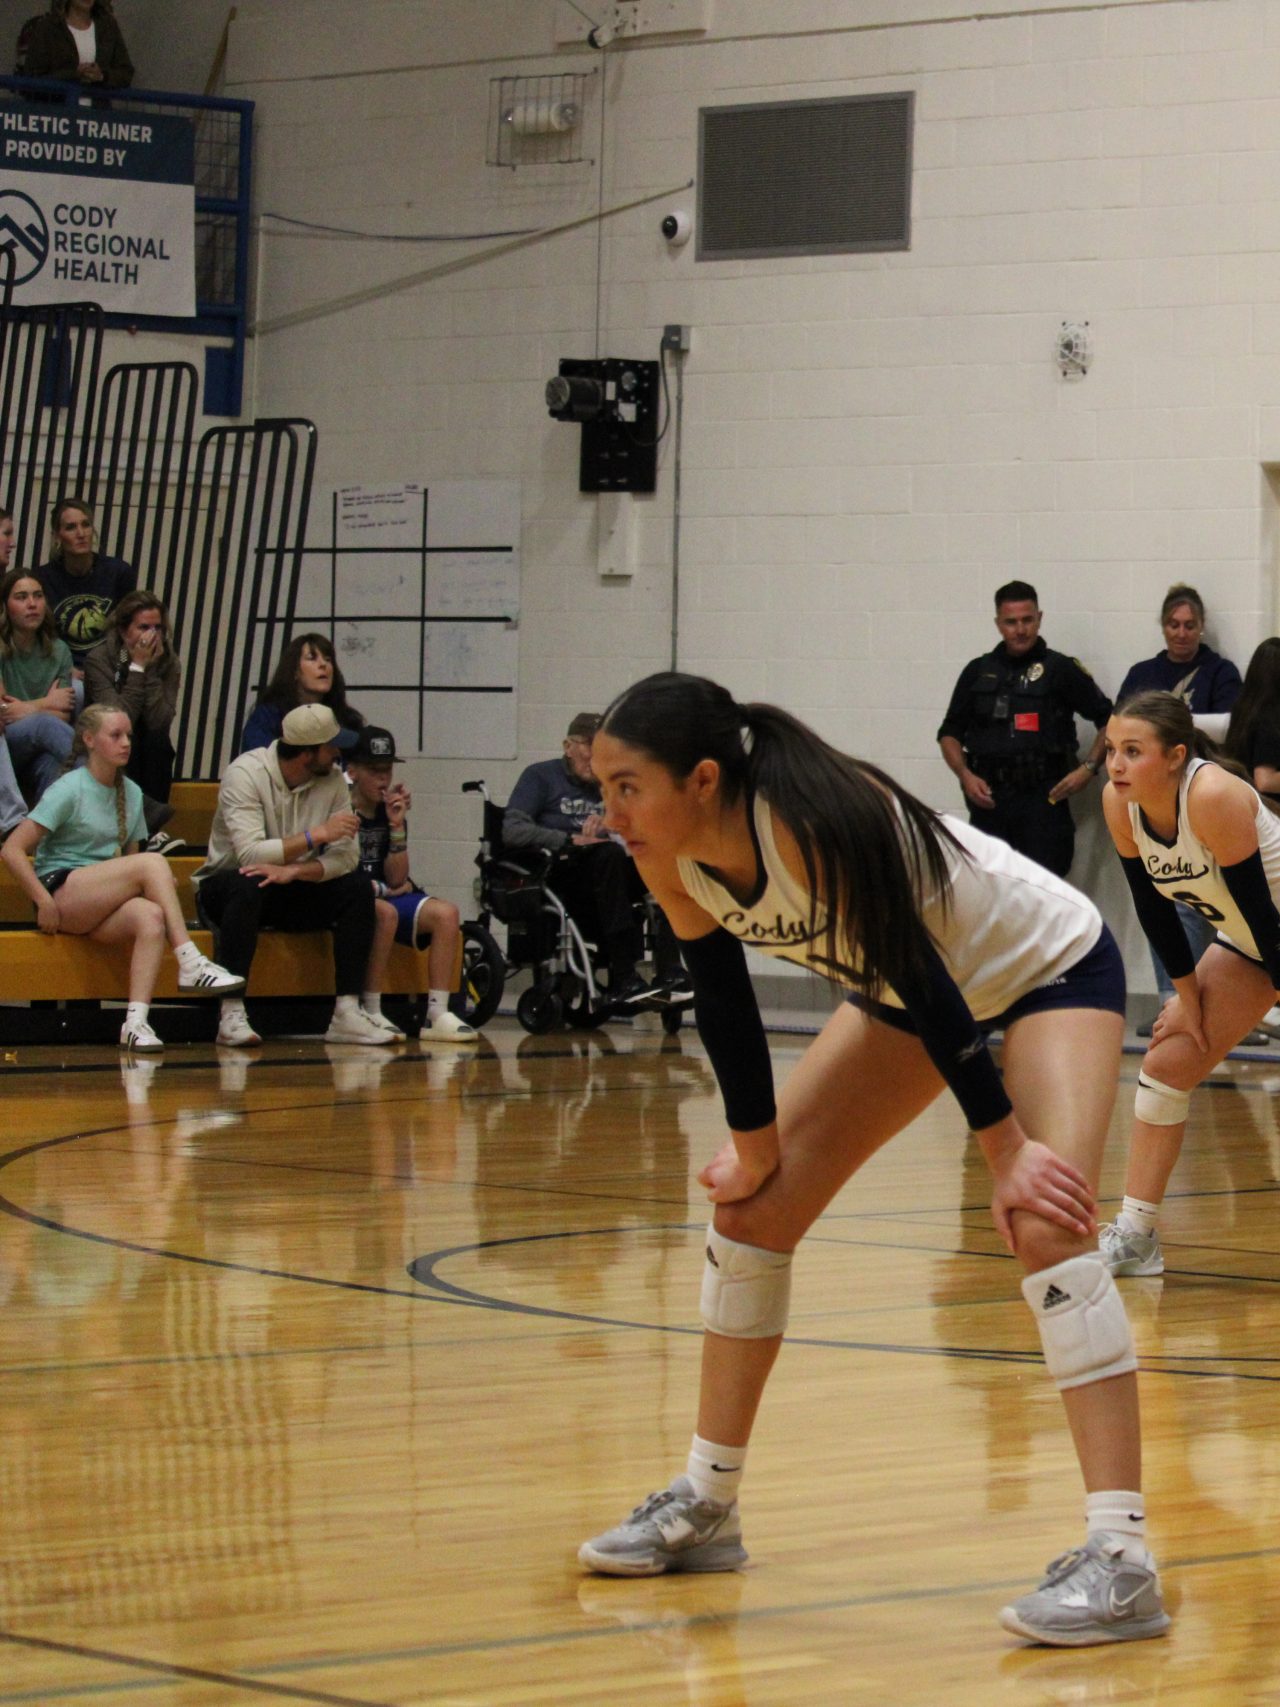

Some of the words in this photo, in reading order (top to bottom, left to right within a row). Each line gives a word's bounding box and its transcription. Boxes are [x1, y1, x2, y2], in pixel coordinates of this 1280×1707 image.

[0, 112, 70, 135] HLETIC
[76, 119, 153, 143] TRAINER
[5, 139, 97, 164] PROVIDED
[103, 148, 127, 167] BY
[53, 203, 117, 229] CODY
[54, 231, 170, 261] REGIONAL
[54, 258, 139, 285] HEALTH
[1147, 855, 1194, 878] Cody
[722, 910, 811, 944] Cody
